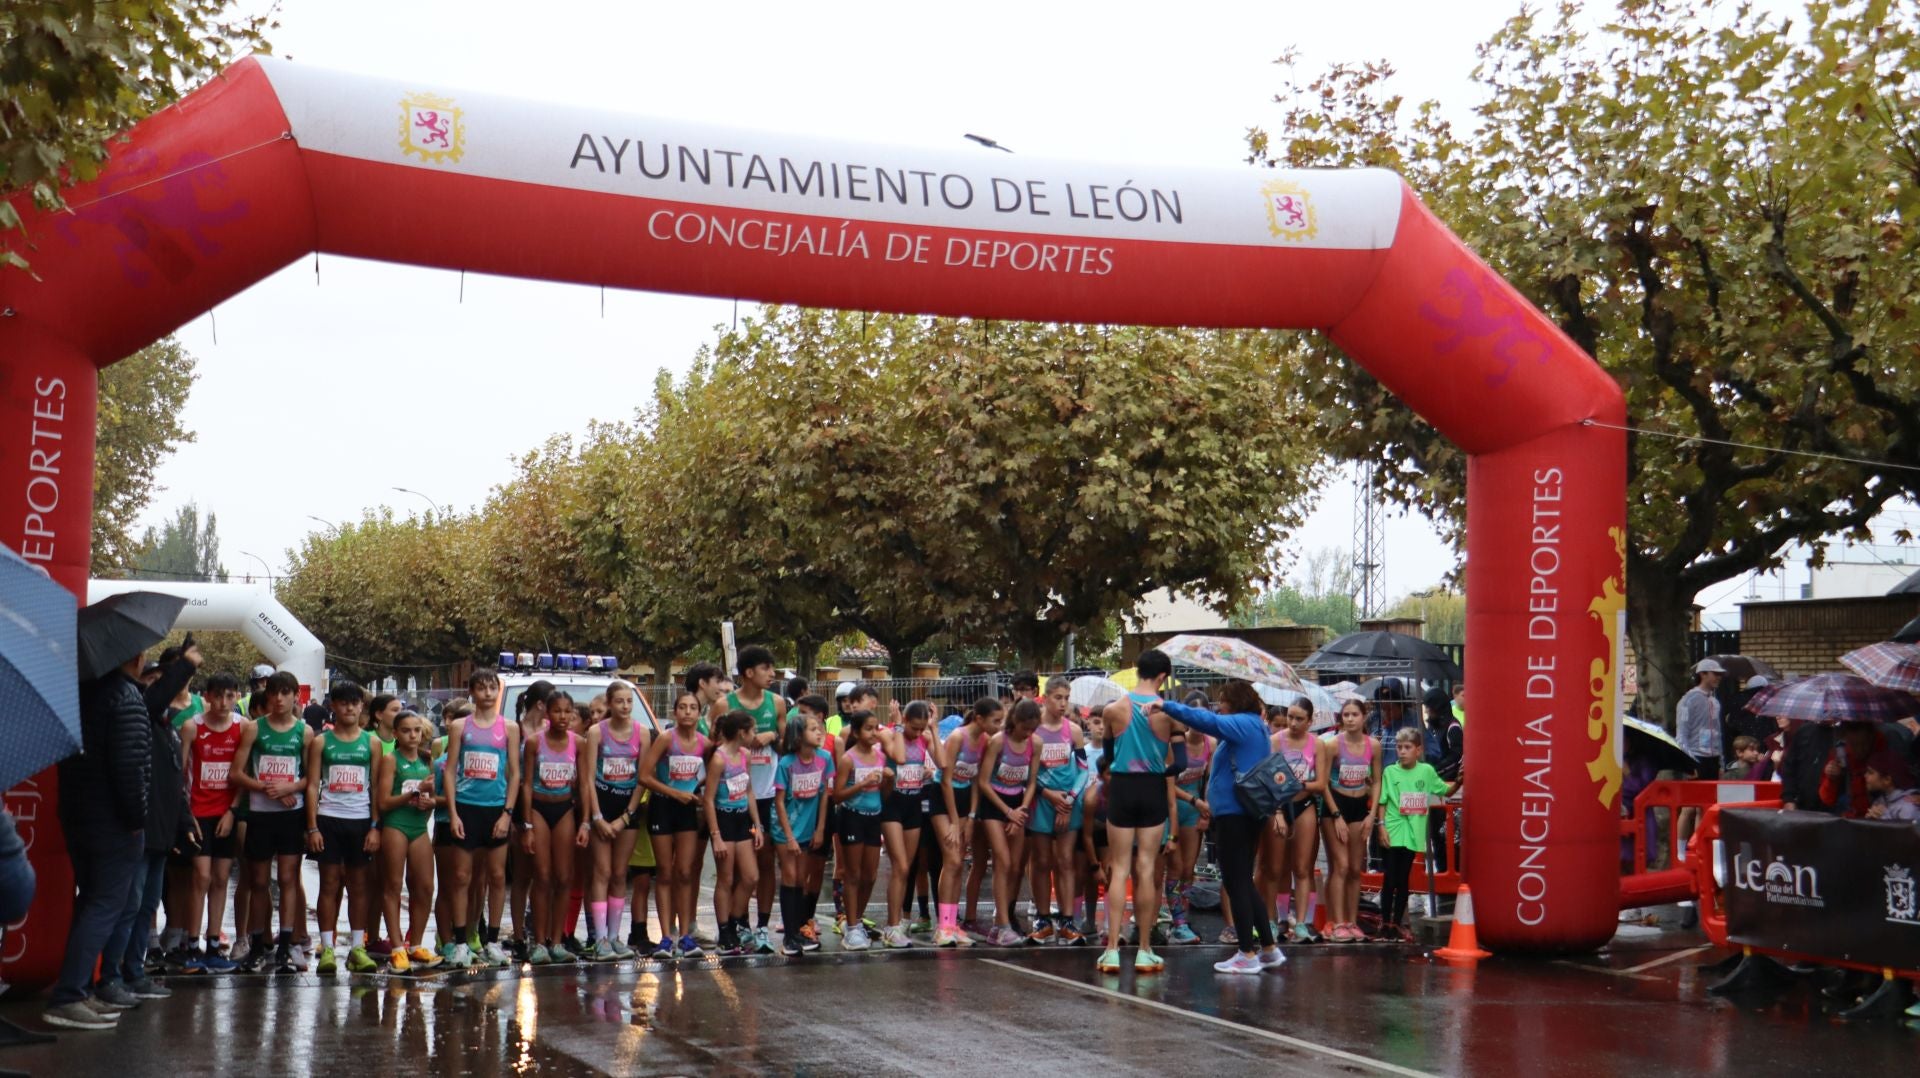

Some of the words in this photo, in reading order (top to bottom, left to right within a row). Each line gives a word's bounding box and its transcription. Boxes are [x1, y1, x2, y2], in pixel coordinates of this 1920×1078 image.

[570, 133, 974, 210] AYUNTAMIENTO
[991, 177, 1050, 216] DE
[1066, 179, 1183, 224] LEÓN
[648, 209, 870, 259] CONCEJALÍA
[885, 232, 931, 264] DE
[944, 238, 1114, 276] DEPORTES
[1528, 467, 1563, 640] DEPORTES
[258, 612, 294, 647] DEPORTES
[1526, 655, 1555, 699] DE
[266, 761, 289, 775] 2021
[336, 771, 359, 783] 2018
[469, 758, 493, 770] 2005
[1516, 714, 1555, 927] CONCEJALÍA
